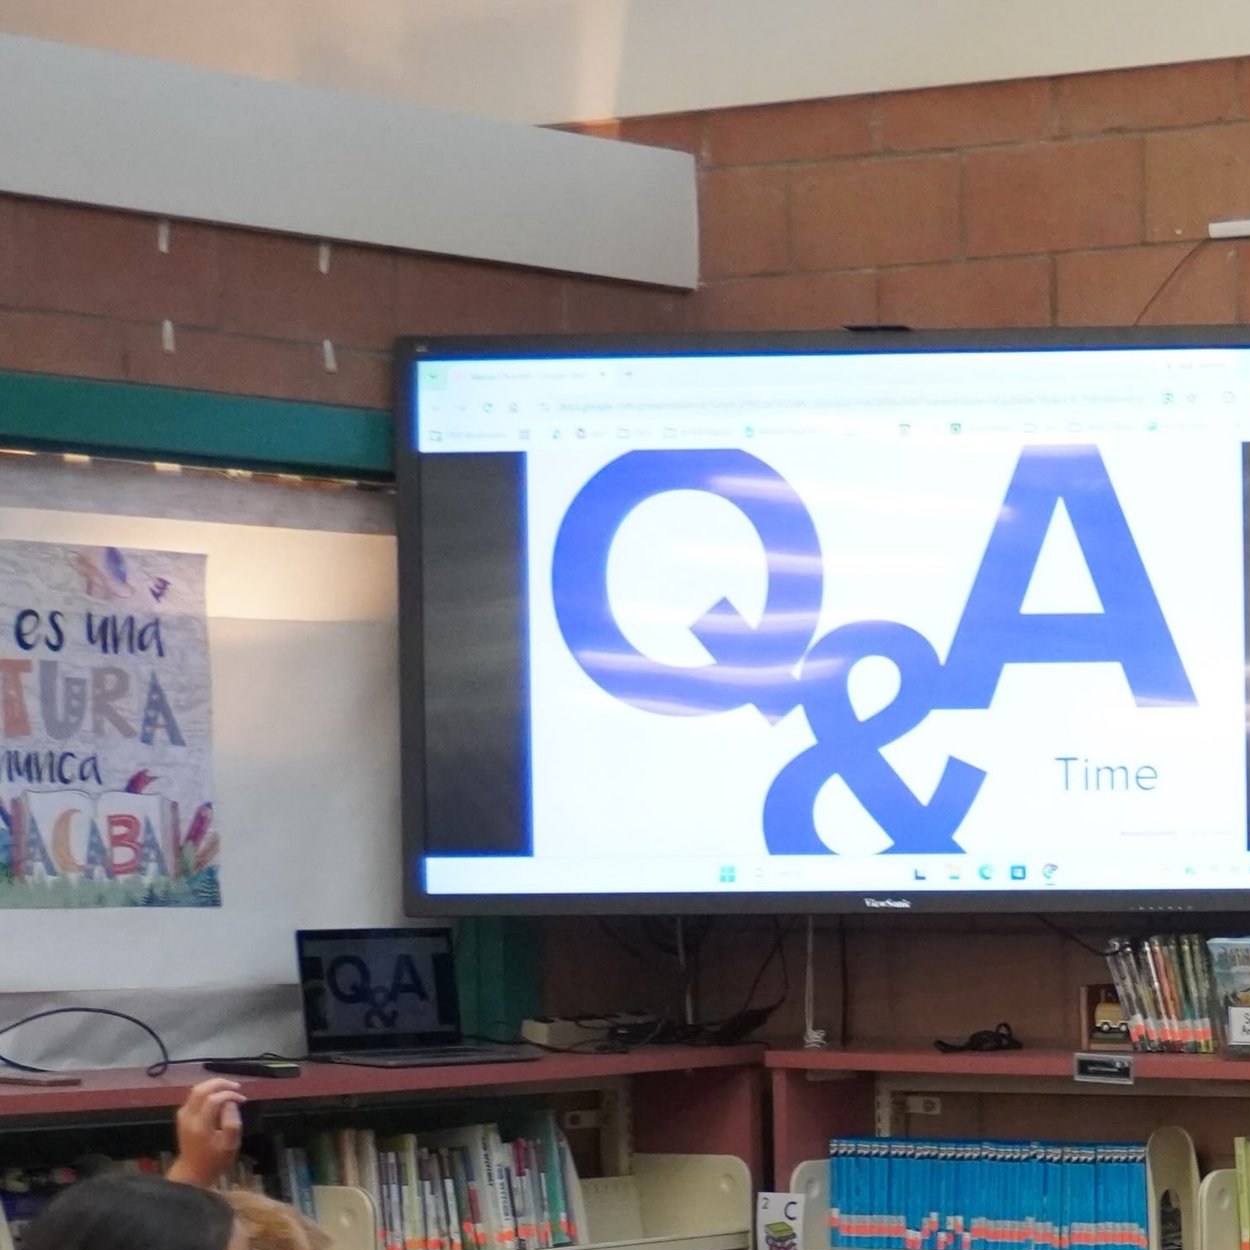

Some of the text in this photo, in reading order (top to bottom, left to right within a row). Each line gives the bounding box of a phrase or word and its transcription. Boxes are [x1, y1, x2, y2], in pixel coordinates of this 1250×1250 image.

[15, 608, 165, 658] es una
[1055, 756, 1158, 792] Time
[24, 808, 169, 878] ACABA
[864, 897, 912, 909] ViewSonic
[762, 1197, 769, 1210] 2
[784, 1201, 797, 1221] C
